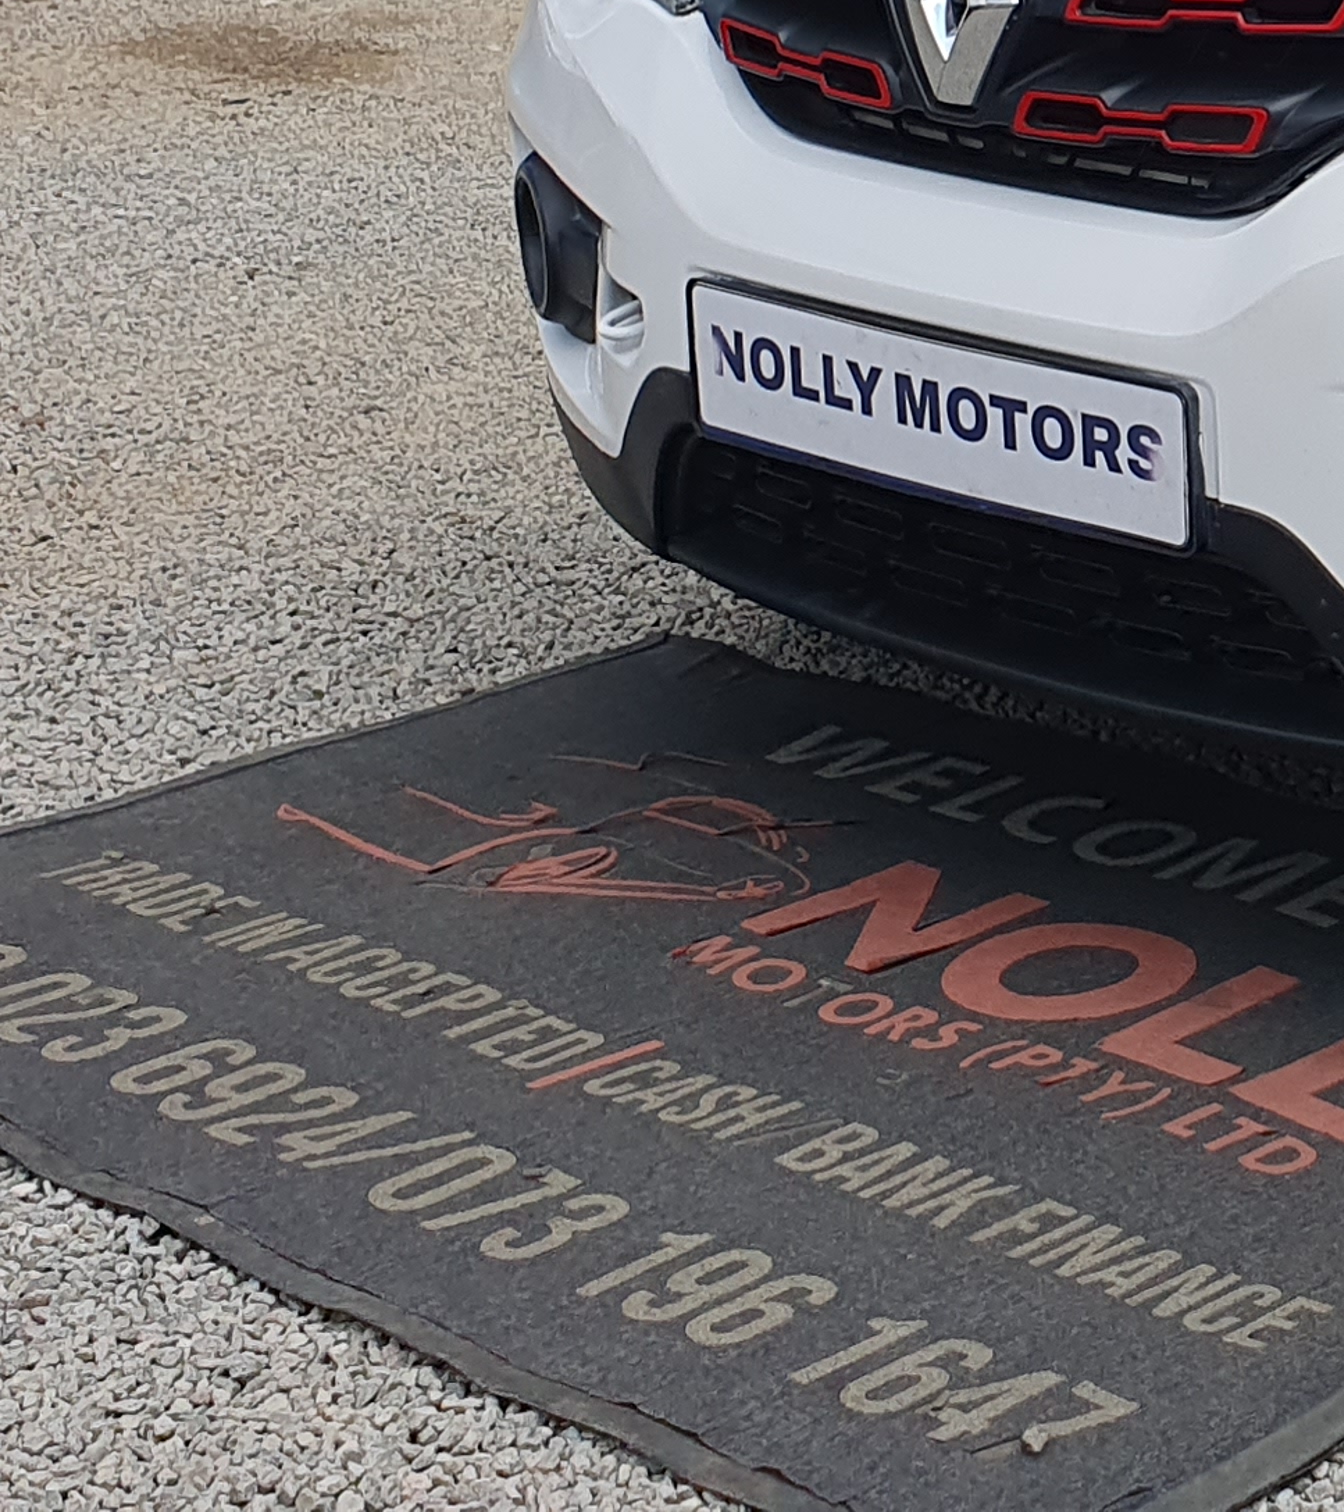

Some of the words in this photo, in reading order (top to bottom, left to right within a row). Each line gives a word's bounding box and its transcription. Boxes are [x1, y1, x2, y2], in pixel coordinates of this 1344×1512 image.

[710, 324, 883, 418] NOLLY
[894, 370, 1164, 482] MOTORS
[40, 850, 262, 933] TRADE
[967, 1197, 1335, 1349] FINANCE
[670, 933, 984, 1051] MOTORS
[960, 1037, 1173, 1121] (PTY)
[1161, 1100, 1319, 1176] LTD
[576, 1231, 840, 1348] 196
[787, 1315, 1142, 1454] 1647
